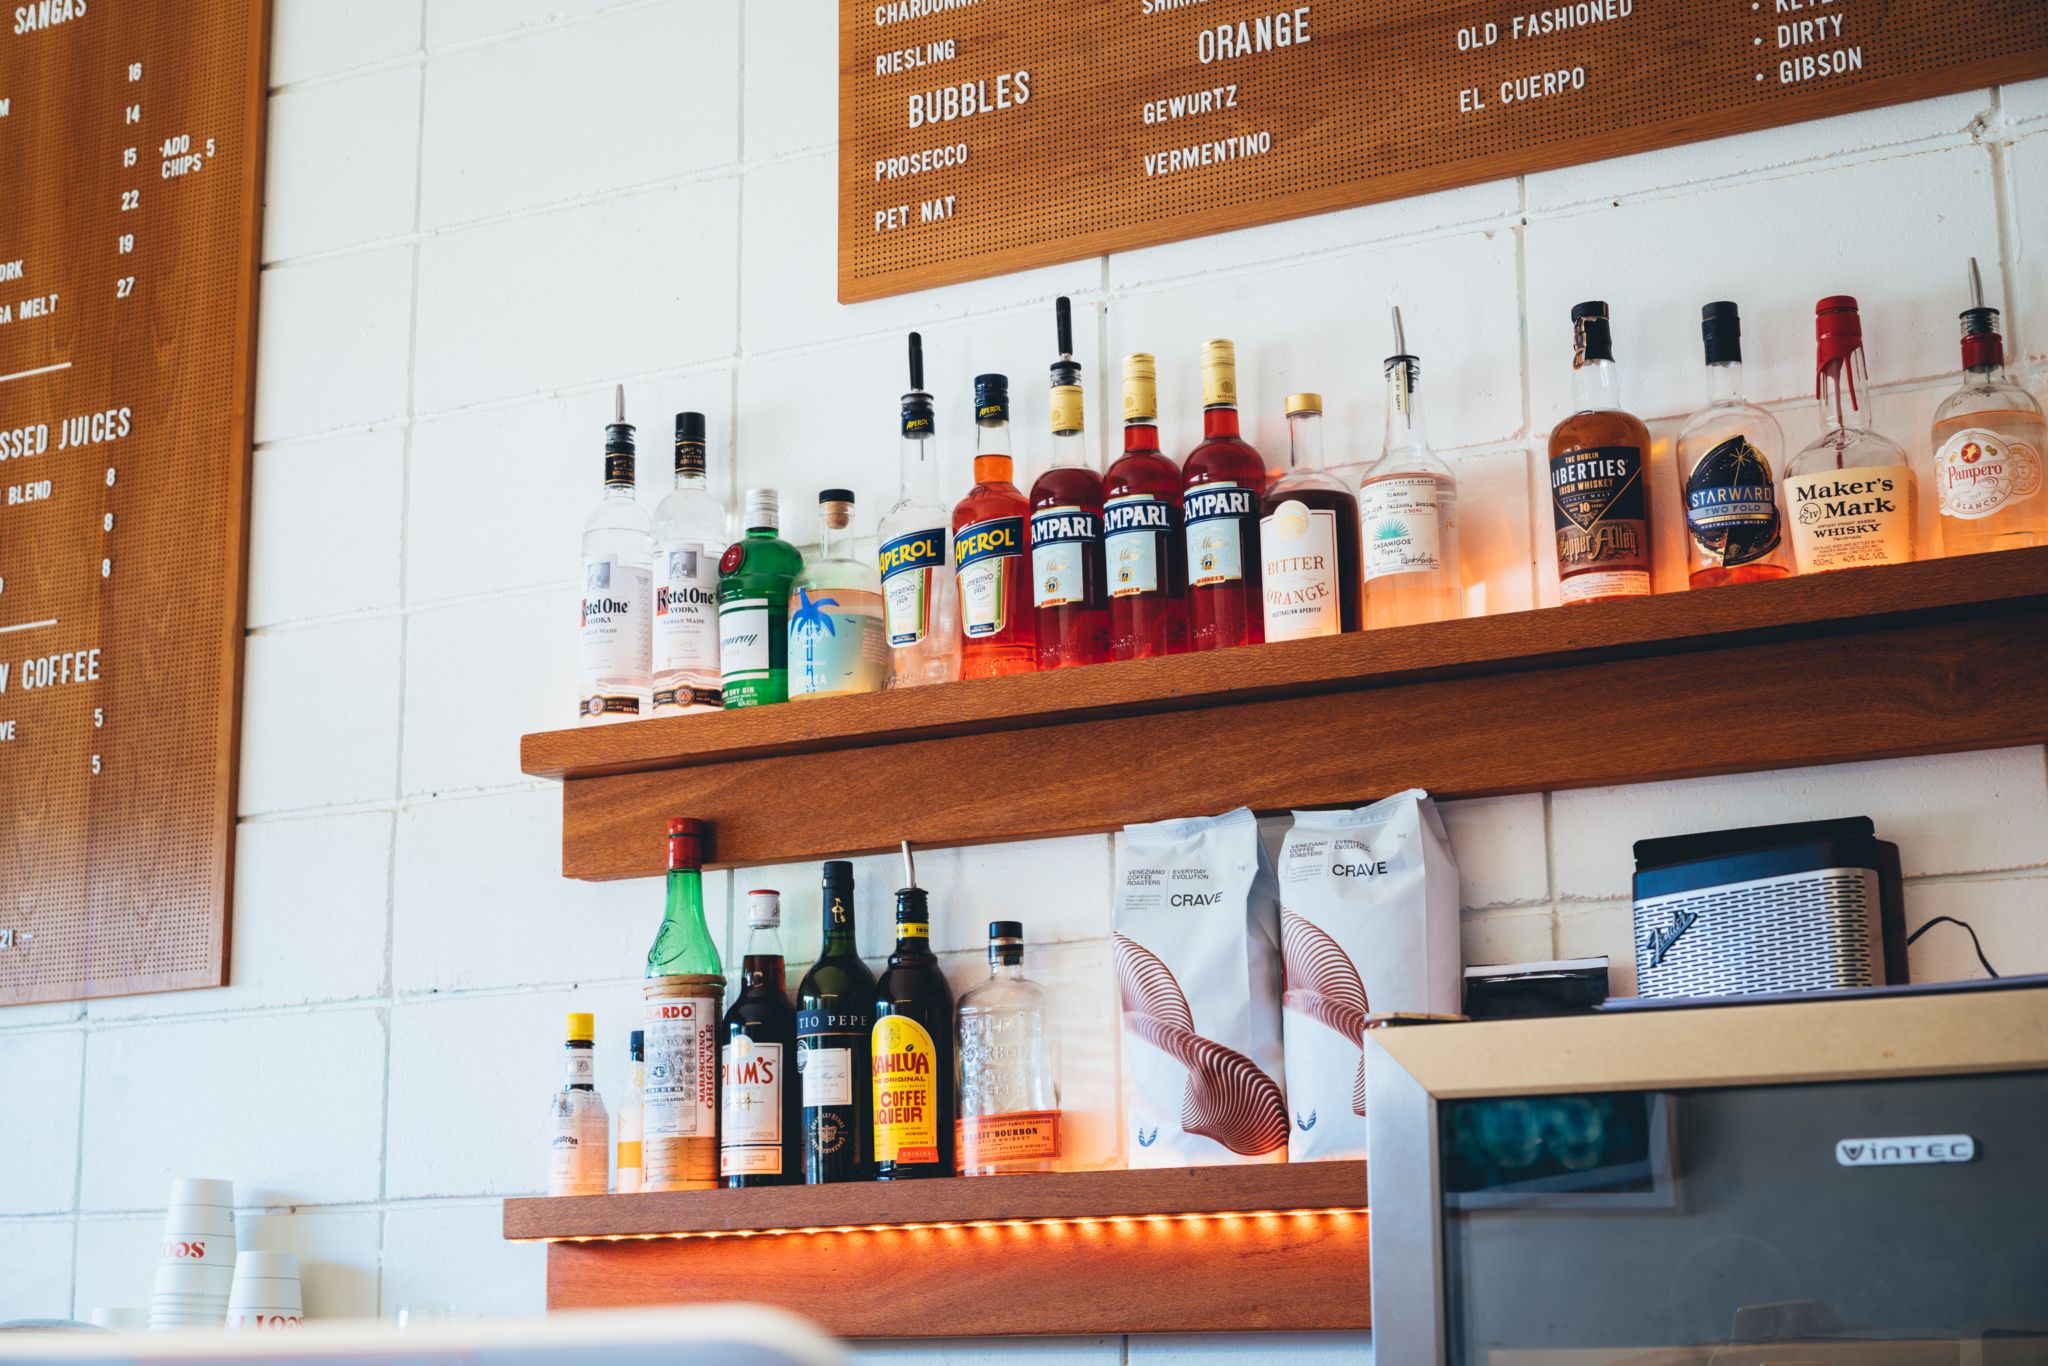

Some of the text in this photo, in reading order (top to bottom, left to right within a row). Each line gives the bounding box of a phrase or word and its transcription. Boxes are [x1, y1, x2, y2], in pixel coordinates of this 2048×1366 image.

[14, 0, 87, 35] SANGAS
[1457, 0, 1633, 52] OLD FASHIONED
[1198, 6, 1311, 65] ORANGE
[1777, 13, 1843, 49] DIRTY
[876, 38, 956, 77] RIESLING
[1780, 46, 1863, 84] GIBSON
[128, 62, 142, 82] 16
[908, 70, 1030, 129] BUBBLES
[1460, 66, 1586, 114] EL CUERPO
[125, 105, 140, 125] 14
[1143, 84, 1238, 125] GEWURTZ
[123, 147, 137, 167] 15
[162, 138, 216, 179] CHIPS 5
[163, 134, 191, 159] ADD
[1144, 131, 1271, 177] VERMENTINO
[875, 143, 968, 182] PROSECCO
[121, 190, 139, 211] 22
[875, 196, 957, 232] PET NAT
[118, 234, 134, 253] 19
[117, 277, 135, 298] 27
[20, 293, 59, 320] MELT
[59, 407, 131, 450] JUICES
[106, 467, 116, 487] 8
[1552, 459, 1626, 489] LIBERTIES
[1947, 464, 2003, 490] Pampero
[8, 480, 52, 505] BLEND
[1559, 479, 1613, 496] IRISH WHISKEY
[1692, 487, 1772, 507] STARWARD
[1796, 478, 1894, 502] Maker's
[1103, 505, 1167, 534] AMPARI
[1184, 492, 1250, 524] AMPARI
[1579, 502, 1590, 513] 10
[1704, 506, 1728, 515] TWO
[1824, 497, 1895, 519] Mark
[104, 513, 113, 532] 8
[1031, 516, 1093, 545] AMPARI
[1813, 523, 1881, 538] WHISKY
[955, 528, 1014, 567] APEROL
[1373, 538, 1411, 550] CASAMIGOS
[102, 558, 111, 577] 8
[879, 539, 936, 578] APEROL
[1267, 555, 1325, 576] BITTER
[603, 597, 628, 614] One
[657, 587, 714, 612] Ketel One
[1266, 582, 1330, 606] ORANGE
[670, 606, 699, 614] VODKA
[22, 648, 101, 690] COFFEE
[94, 708, 104, 728] 5
[92, 754, 100, 775] 5
[1332, 861, 1389, 877] CRAVE
[1170, 891, 1223, 907] CRAVE
[799, 1015, 868, 1029] TIO PEPE
[706, 1024, 714, 1109] ORIGINALE
[880, 1090, 926, 1108] COFFEE
[994, 1128, 1038, 1138] BOURBON
